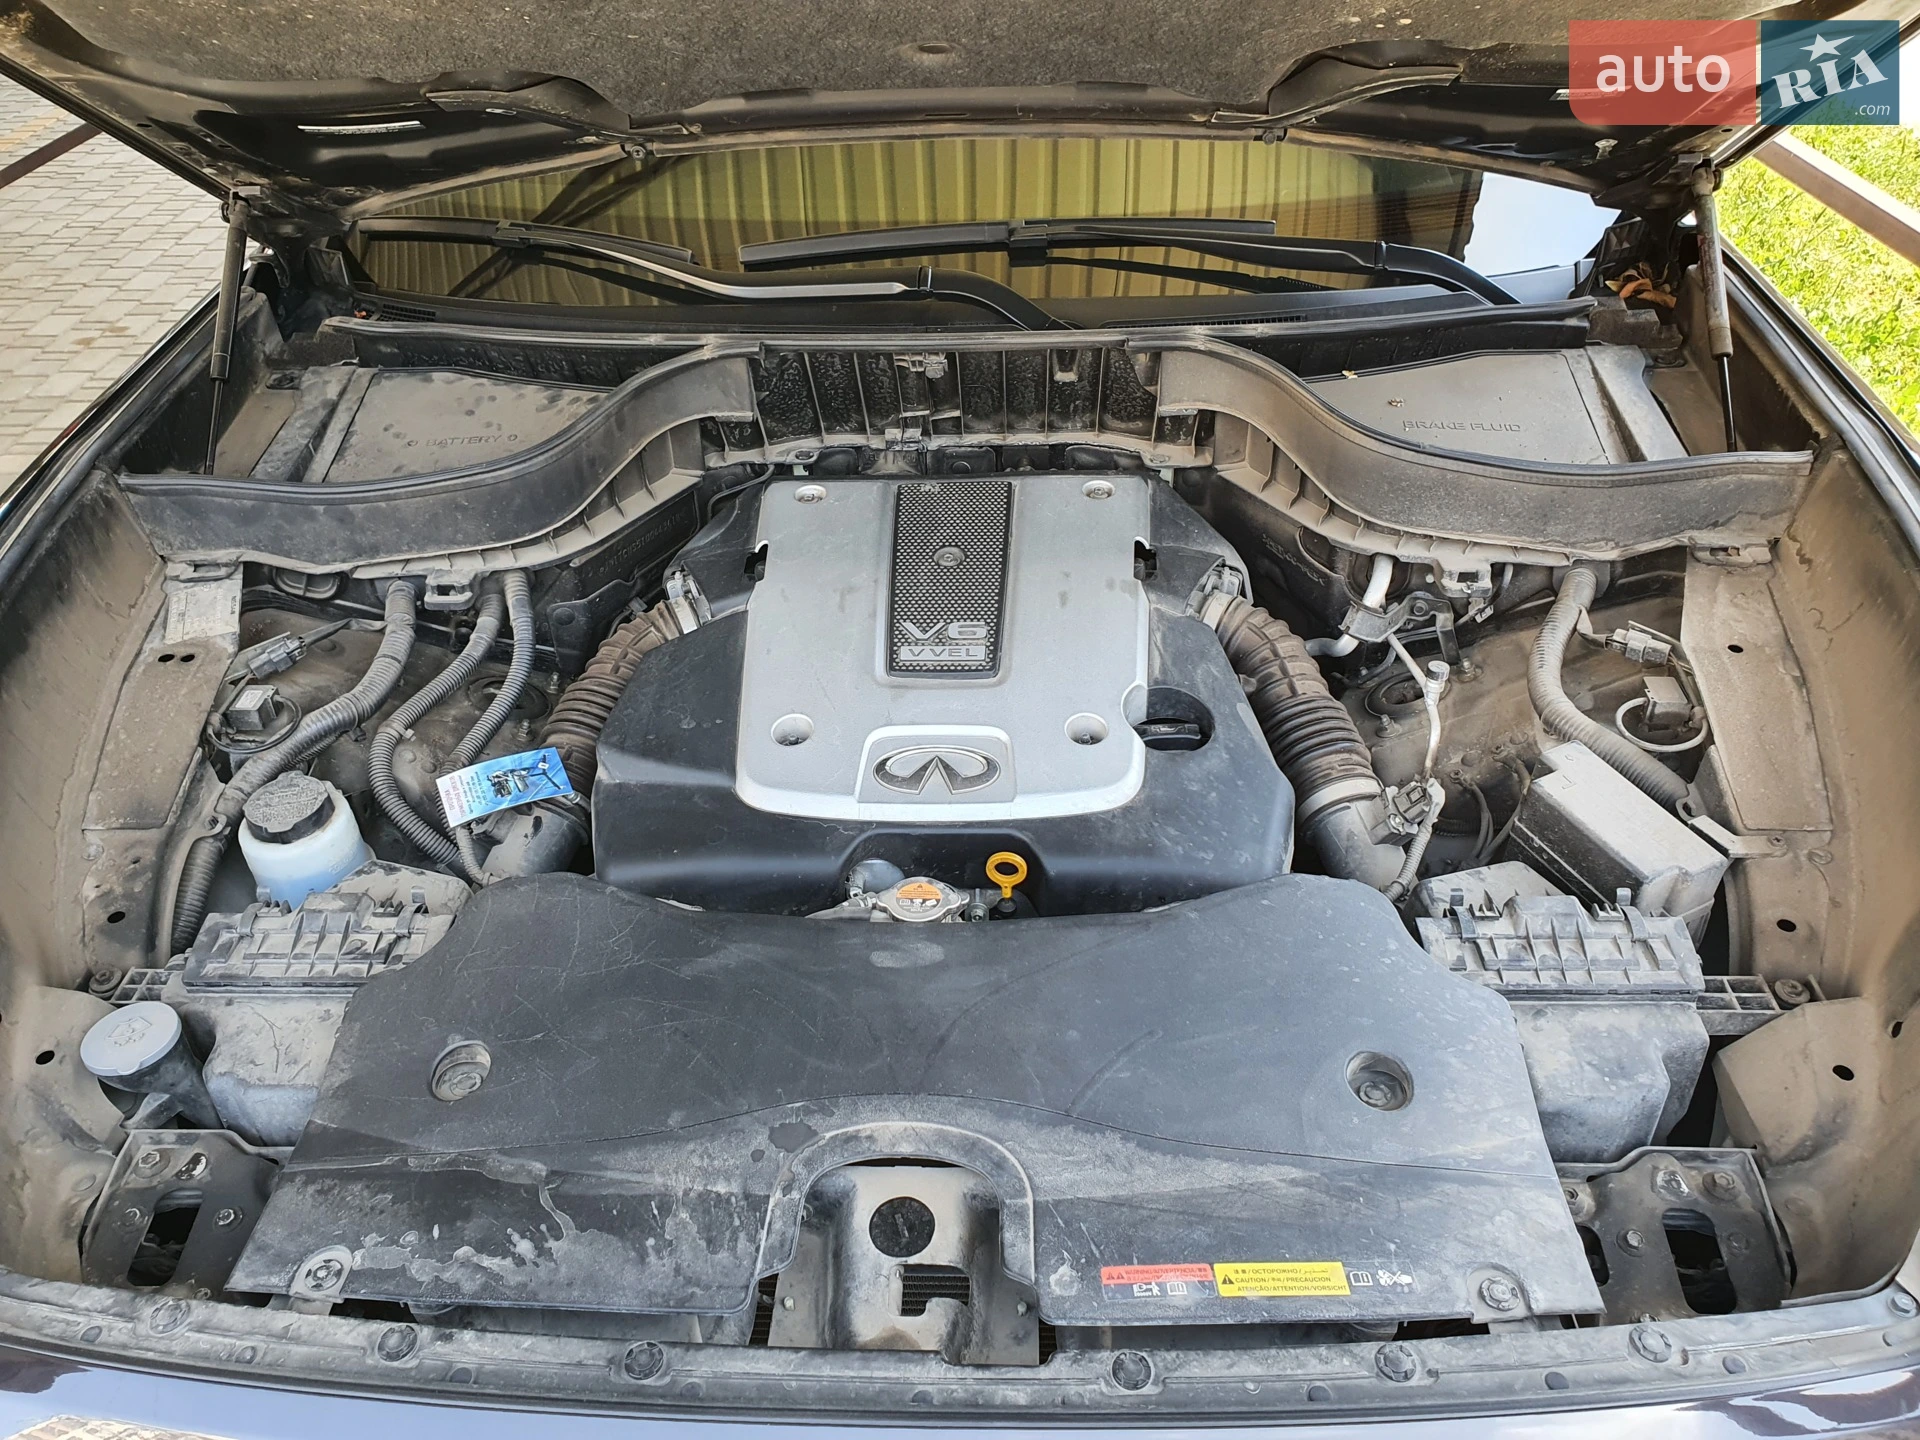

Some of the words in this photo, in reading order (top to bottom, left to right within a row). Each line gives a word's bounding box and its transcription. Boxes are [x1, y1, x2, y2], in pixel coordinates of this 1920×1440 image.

[1402, 420, 1466, 431] BRAKE
[1470, 422, 1521, 432] FLUID
[426, 434, 502, 447] BATTERY
[900, 621, 988, 641] V6
[908, 648, 978, 657] VVEL
